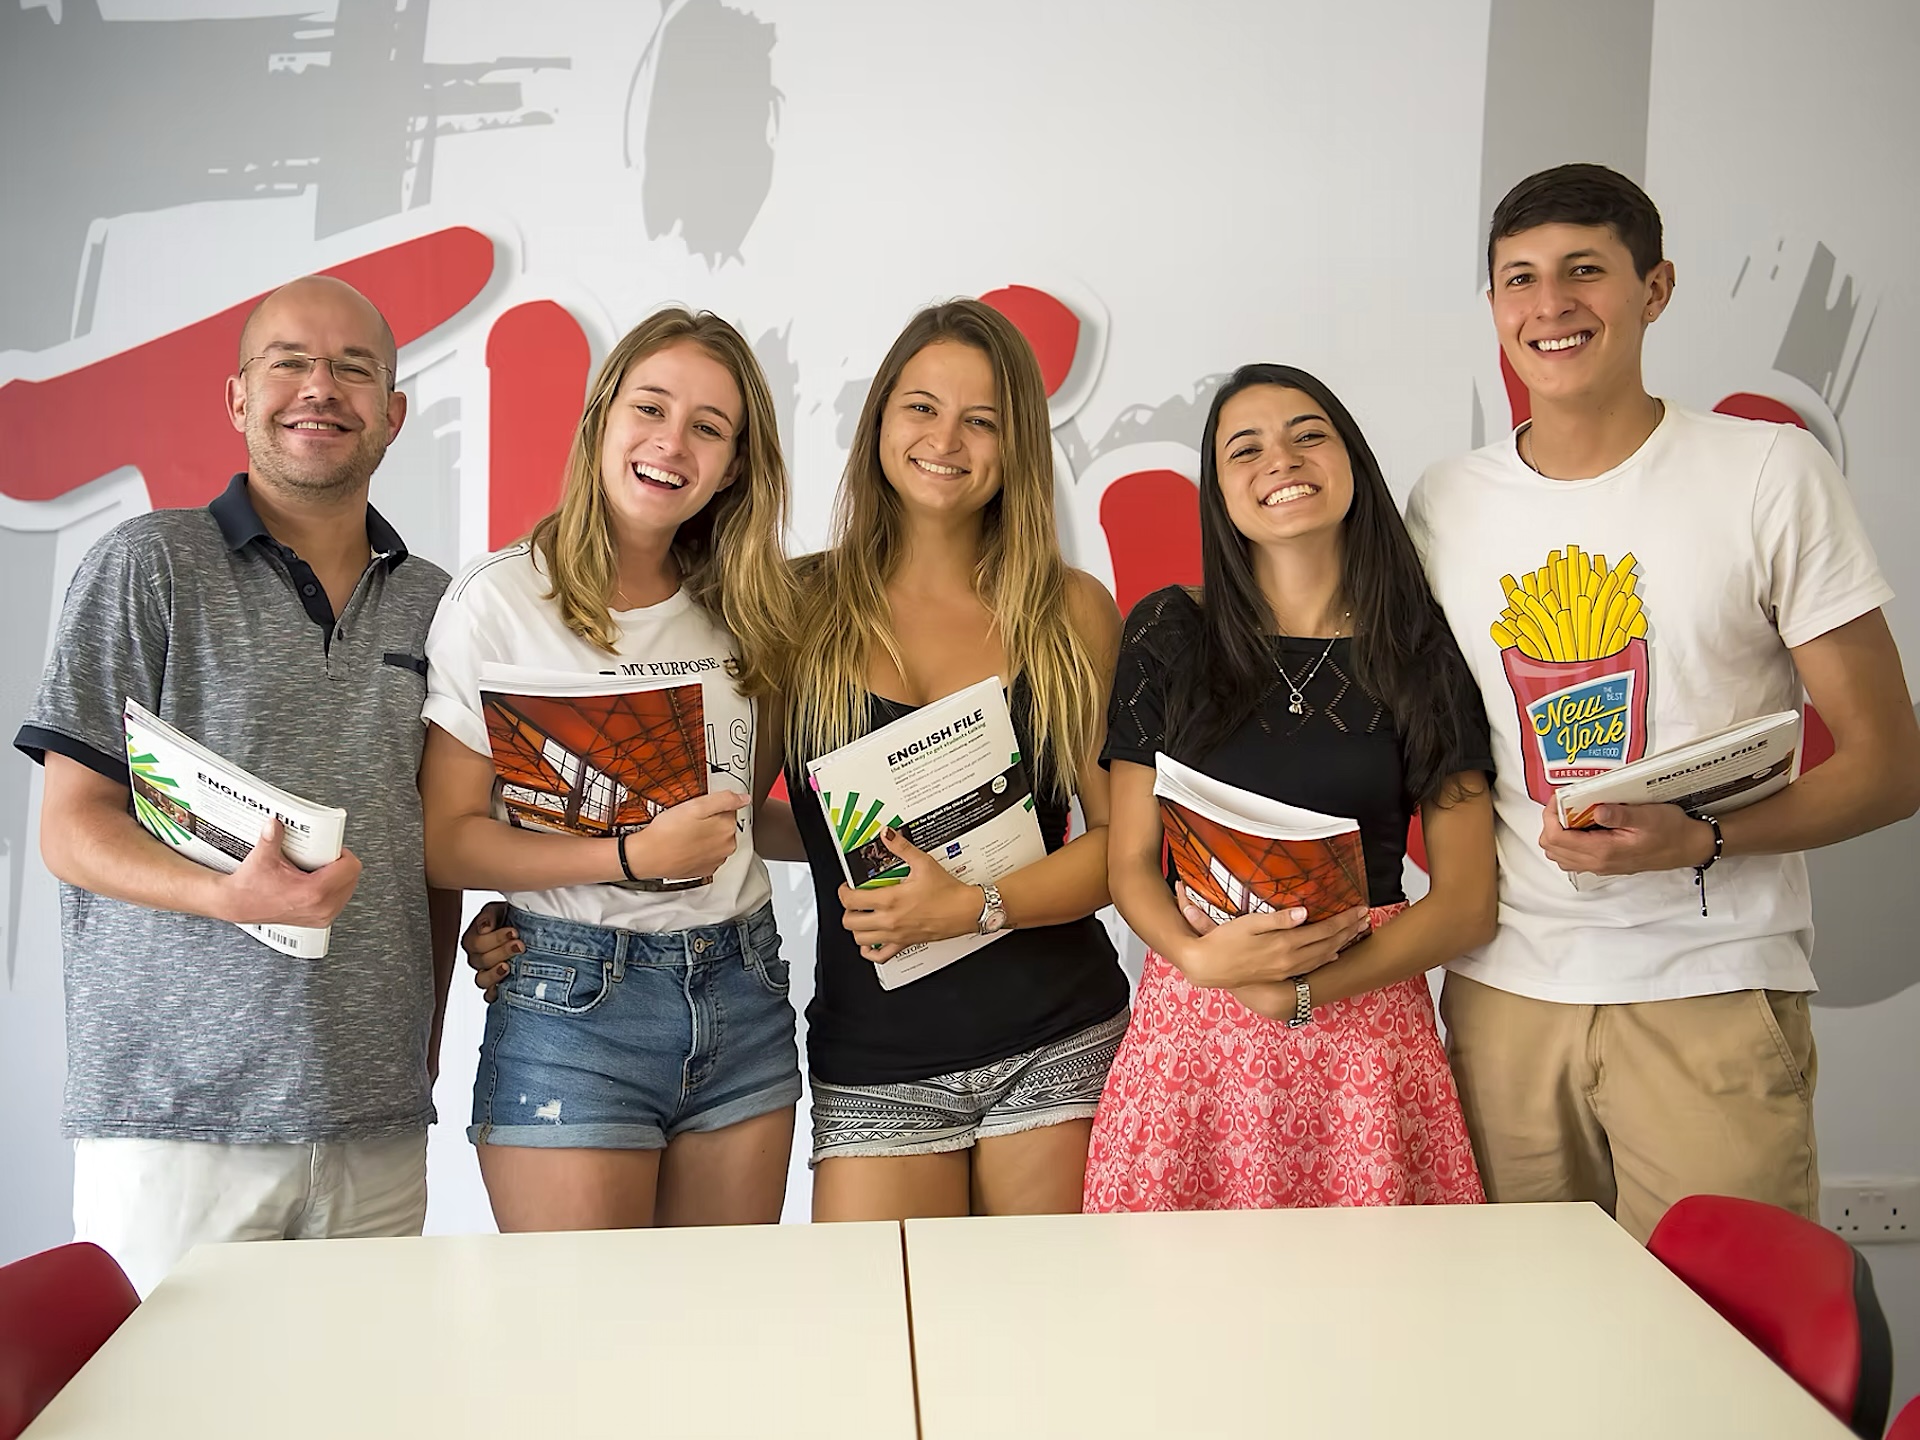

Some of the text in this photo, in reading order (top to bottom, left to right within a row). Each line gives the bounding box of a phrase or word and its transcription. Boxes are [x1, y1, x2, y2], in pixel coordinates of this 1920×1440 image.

[620, 657, 720, 676] MY PURPOSE
[1534, 694, 1605, 736] New
[1606, 692, 1623, 700] BEST
[887, 726, 952, 766] ENGLISH
[953, 708, 984, 733] FILE
[900, 759, 914, 768] best
[944, 731, 967, 748] students
[1557, 713, 1626, 764] York
[1588, 747, 1620, 757] FAST FOOD
[1555, 769, 1590, 777] FRENCH
[1646, 756, 1726, 786] ENGLISH
[1731, 739, 1768, 758] FILE
[197, 772, 270, 814] ENGLISH
[276, 812, 311, 833] FILE
